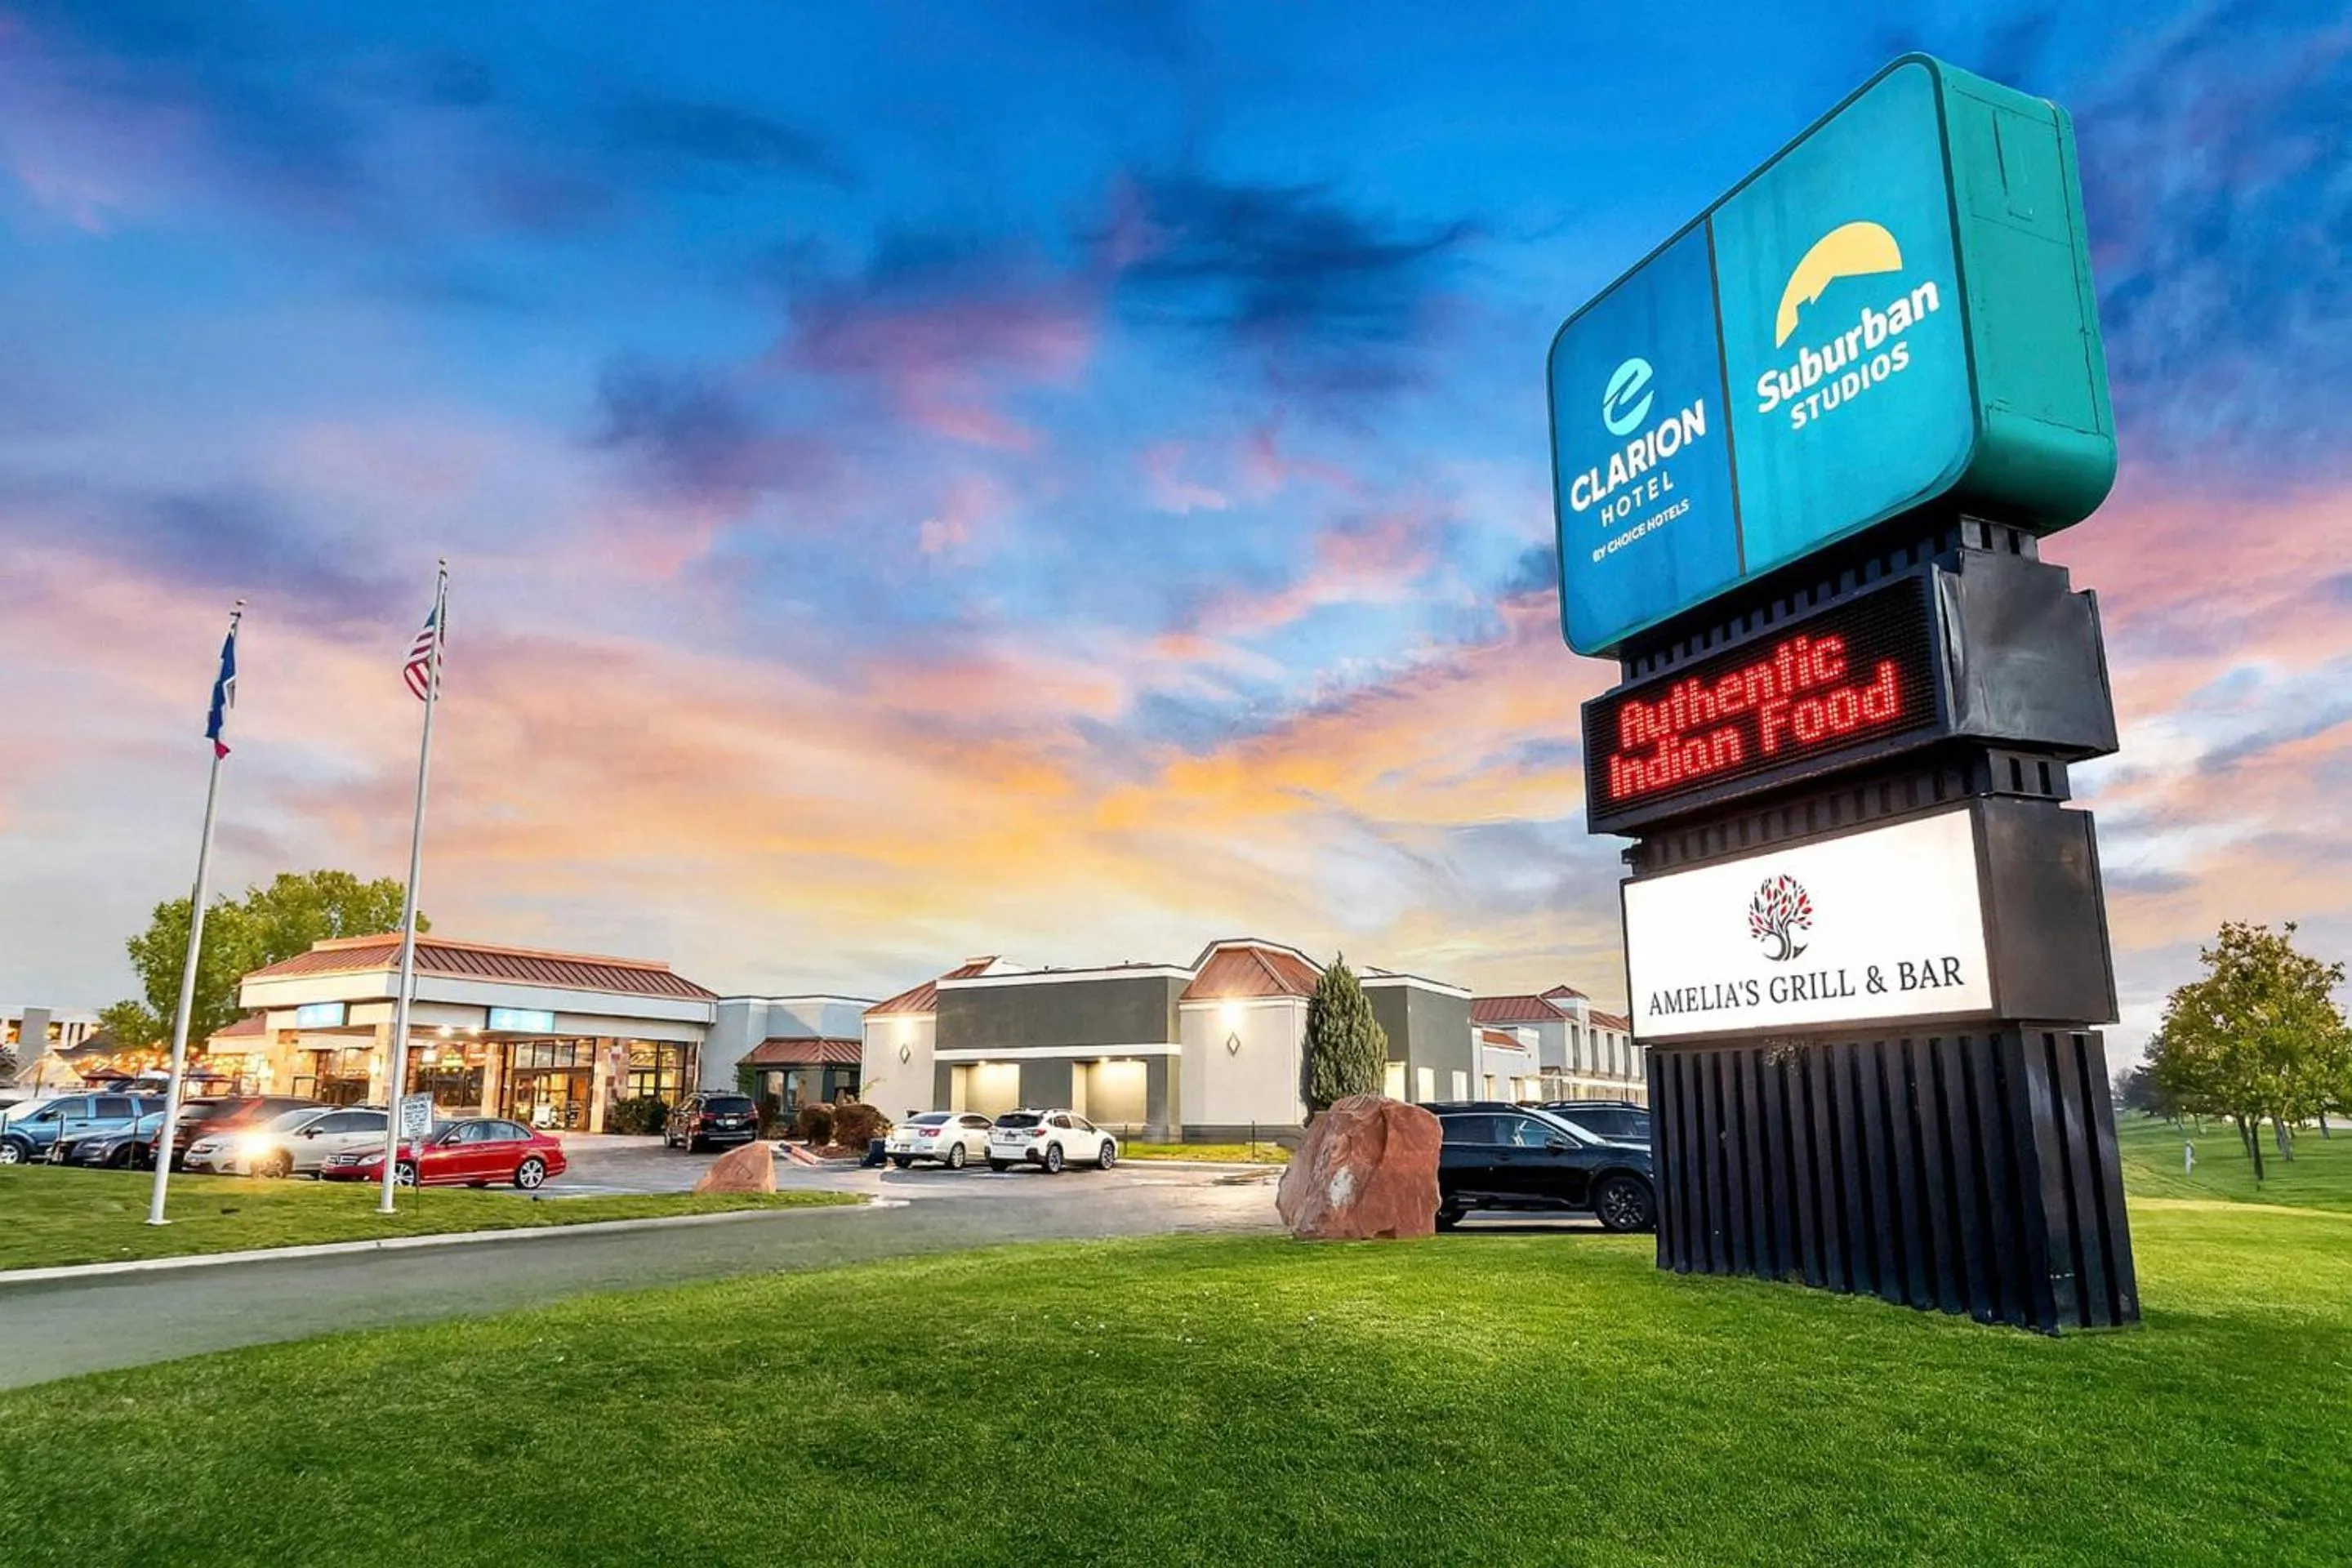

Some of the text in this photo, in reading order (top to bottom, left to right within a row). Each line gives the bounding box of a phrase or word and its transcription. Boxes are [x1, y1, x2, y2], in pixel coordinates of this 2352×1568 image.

[1757, 281, 1940, 413] Suburban
[1791, 341, 1909, 430] STUDIOS
[1570, 399, 1706, 511] CLARION
[1601, 471, 1673, 528] HOTEL
[1607, 523, 1646, 553] CHOICE
[1647, 498, 1690, 531] HOTELS
[1609, 660, 1900, 798] Indian Food
[1619, 634, 1846, 749] Authentic
[1650, 956, 1965, 1016] AMELIA'S GRILL & BAR
